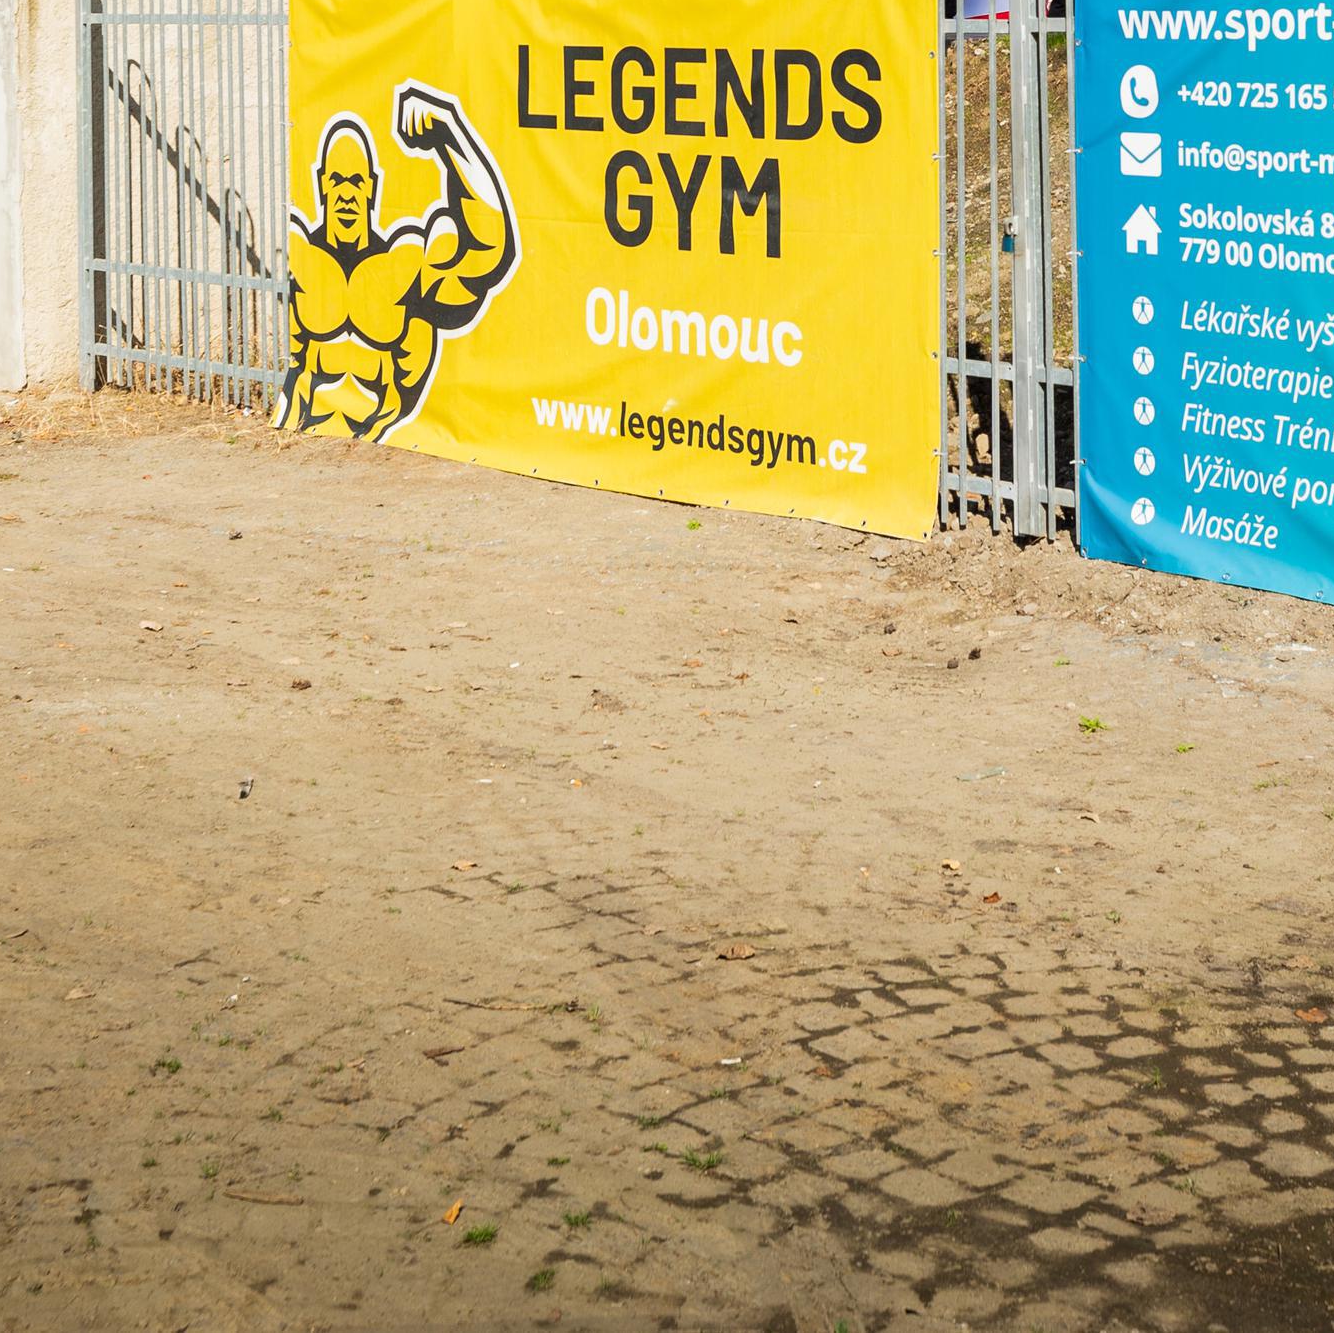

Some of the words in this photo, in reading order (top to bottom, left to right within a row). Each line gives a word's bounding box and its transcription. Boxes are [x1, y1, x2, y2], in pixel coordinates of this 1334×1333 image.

[517, 44, 883, 144] LEGENDS
[1177, 81, 1232, 107] +420
[1236, 82, 1279, 109] 725
[1284, 83, 1328, 110] 165
[604, 150, 782, 259] GYM
[1179, 202, 1315, 238] Sokolovská
[1179, 237, 1221, 264] 779
[1224, 240, 1253, 268] 00
[585, 286, 803, 367] Olomouc
[1181, 300, 1290, 341] Lékařské
[1181, 352, 1334, 403] Fyzioterapie
[531, 398, 867, 474] www.legendsgym.cz
[1181, 403, 1266, 443] Fitness
[1183, 453, 1288, 498] Výživové
[1180, 505, 1278, 549] Masáže
